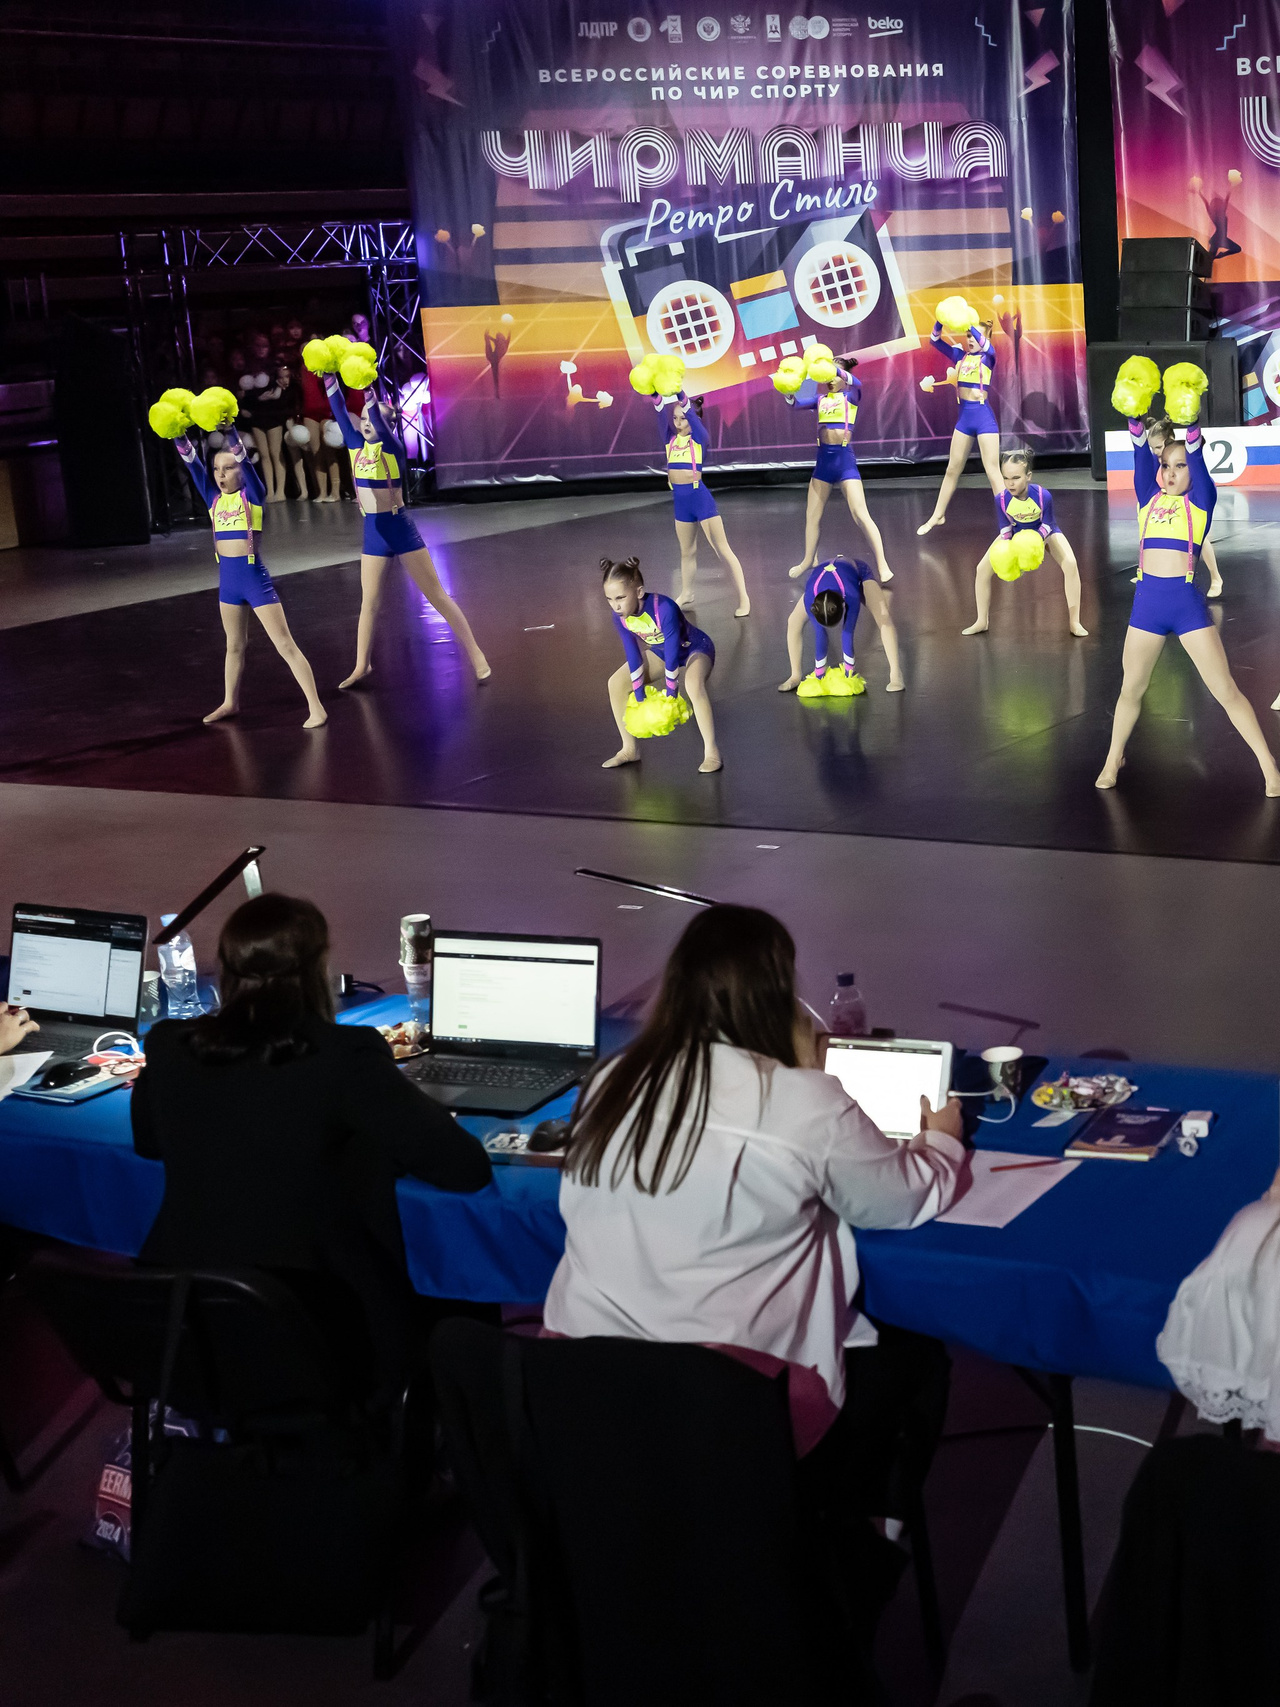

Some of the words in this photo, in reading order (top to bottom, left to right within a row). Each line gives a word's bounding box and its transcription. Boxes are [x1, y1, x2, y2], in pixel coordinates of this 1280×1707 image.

[578, 21, 618, 39] ЛДПР
[867, 16, 904, 30] beko
[539, 64, 746, 84] ВСЕРОССИЙСКИЕ
[756, 63, 945, 79] СОРЕВНОВАНИЯ
[651, 86, 682, 101] ПО
[693, 85, 740, 100] ЧИР
[751, 83, 841, 99] СПОРТУ
[644, 198, 754, 243] Ретро
[769, 179, 878, 220] Стиль
[1209, 440, 1234, 474] 2
[96, 1518, 122, 1543] 2024
